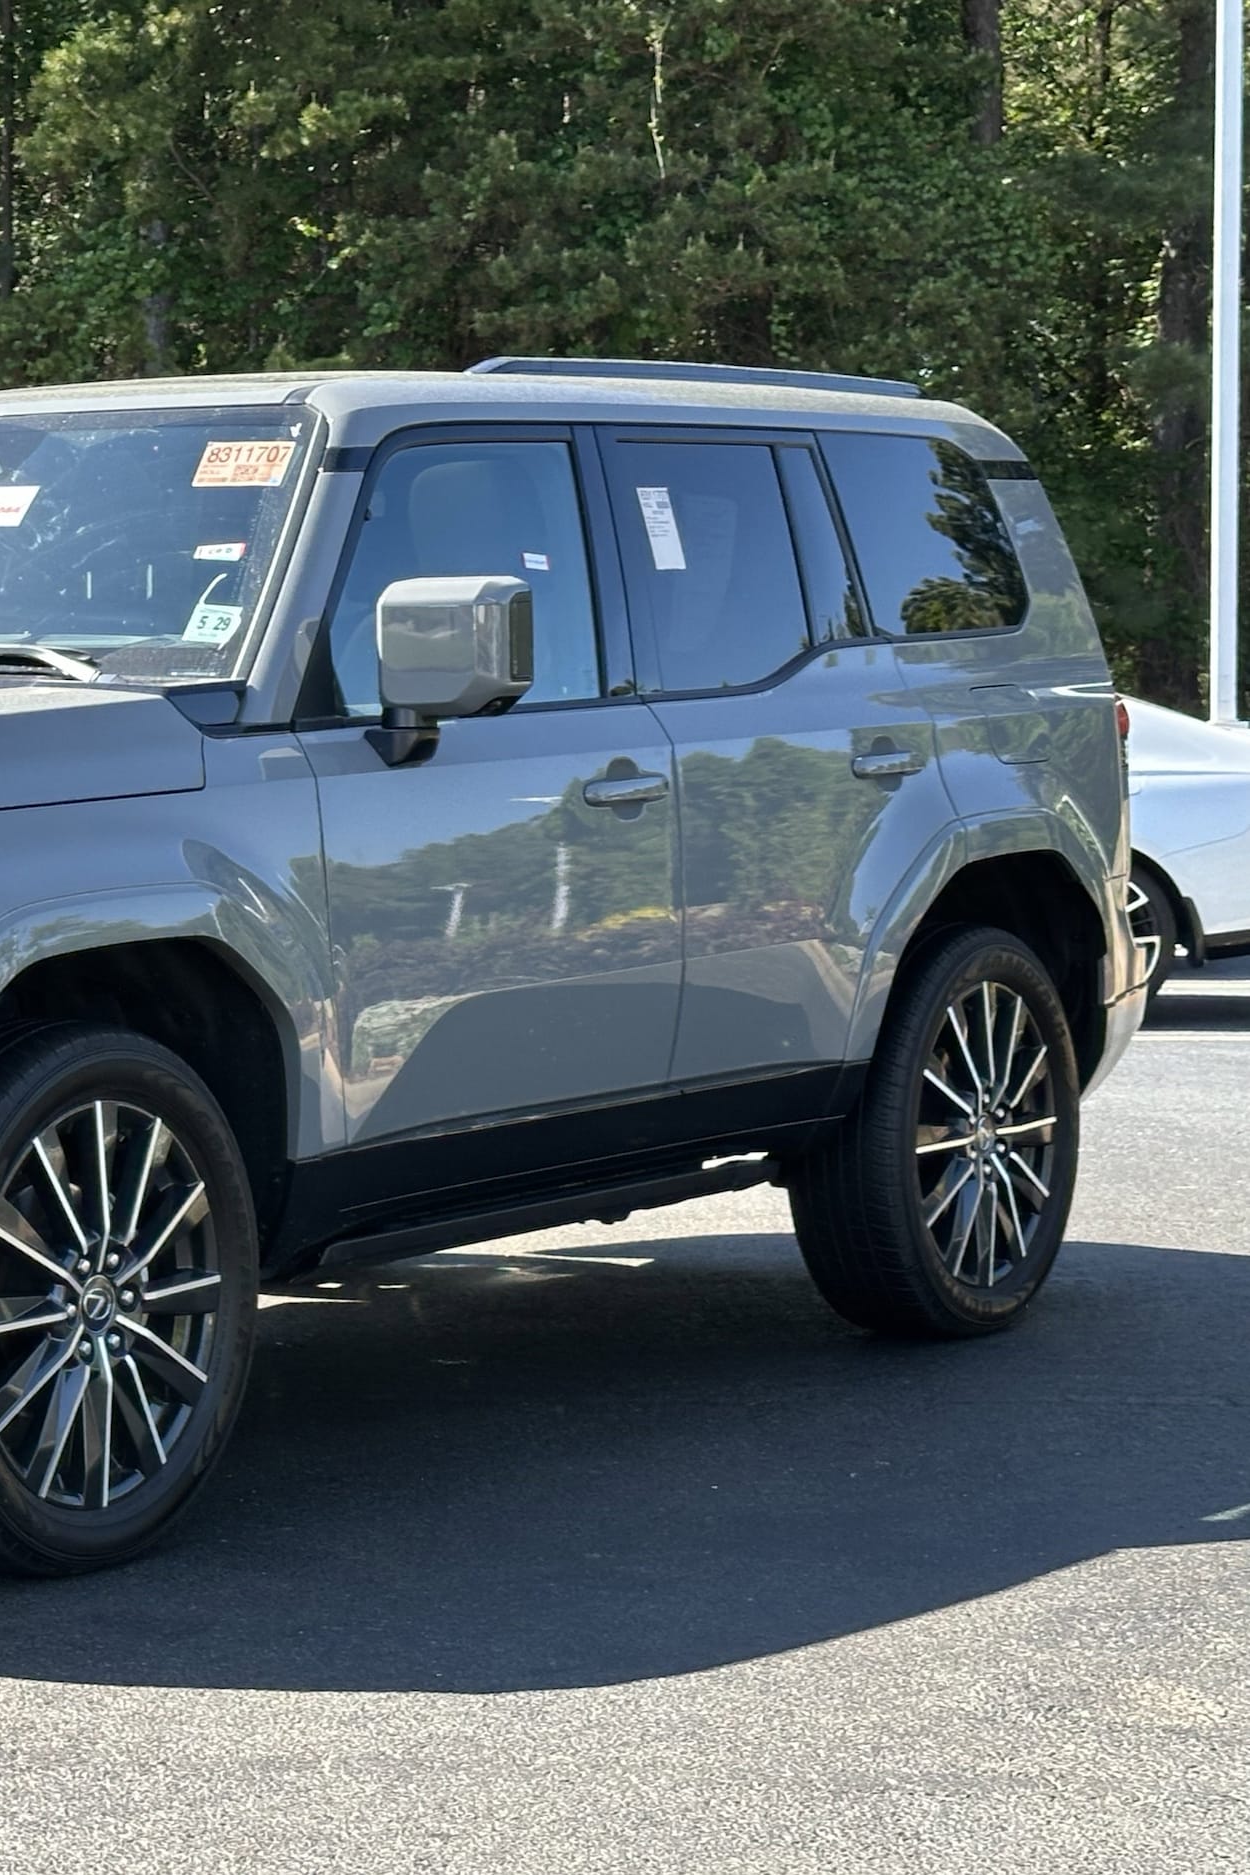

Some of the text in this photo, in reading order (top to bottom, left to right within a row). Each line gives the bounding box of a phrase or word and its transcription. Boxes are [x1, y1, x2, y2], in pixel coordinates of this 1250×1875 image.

[207, 446, 292, 463] 8311707
[197, 616, 232, 631] 5 29
